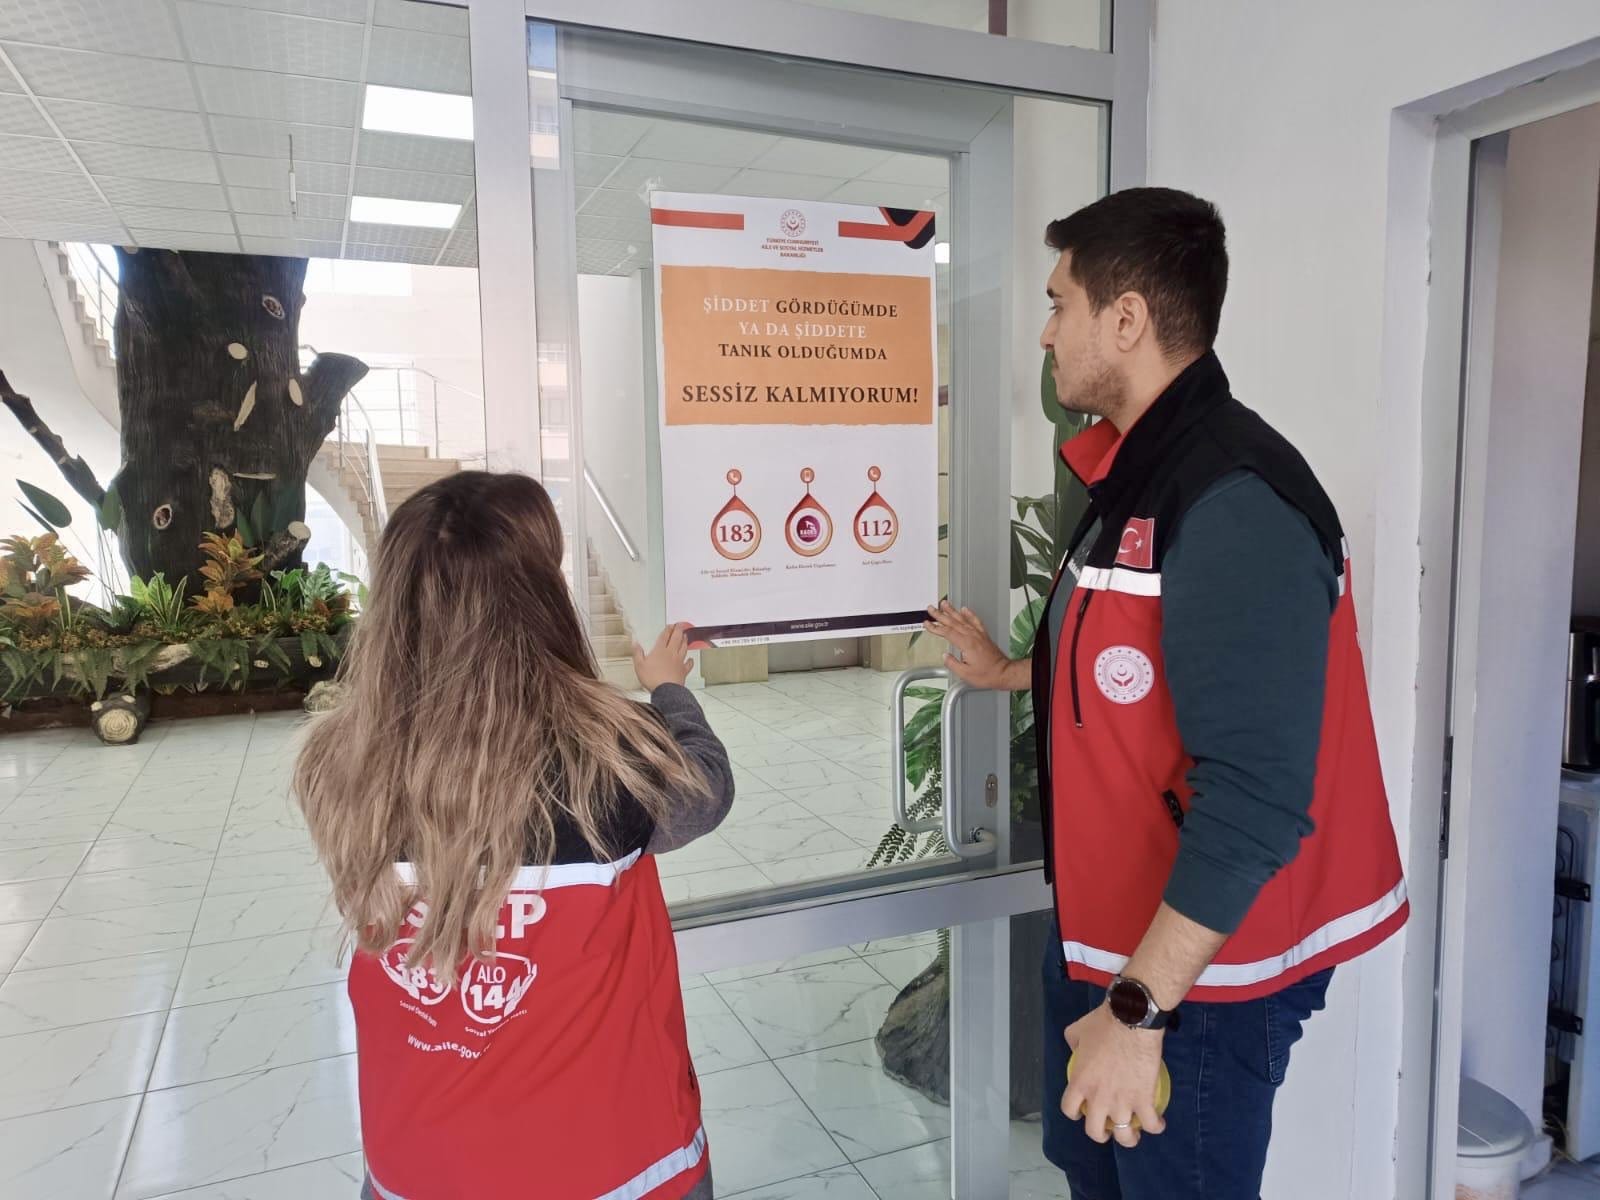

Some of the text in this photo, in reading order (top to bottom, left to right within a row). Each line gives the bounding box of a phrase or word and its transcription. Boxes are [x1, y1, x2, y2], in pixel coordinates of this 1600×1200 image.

[703, 296, 898, 318] ŞİDDET GÖRDÜĞÜMDE
[739, 321, 867, 340] YA DA ŞİDDETE
[718, 343, 888, 361] TANIK OLDUĞUMDA
[682, 382, 919, 404] SESSİZ KALMIYORUM!
[719, 524, 754, 543] 183
[861, 519, 892, 537] 112
[476, 964, 506, 984] ALO
